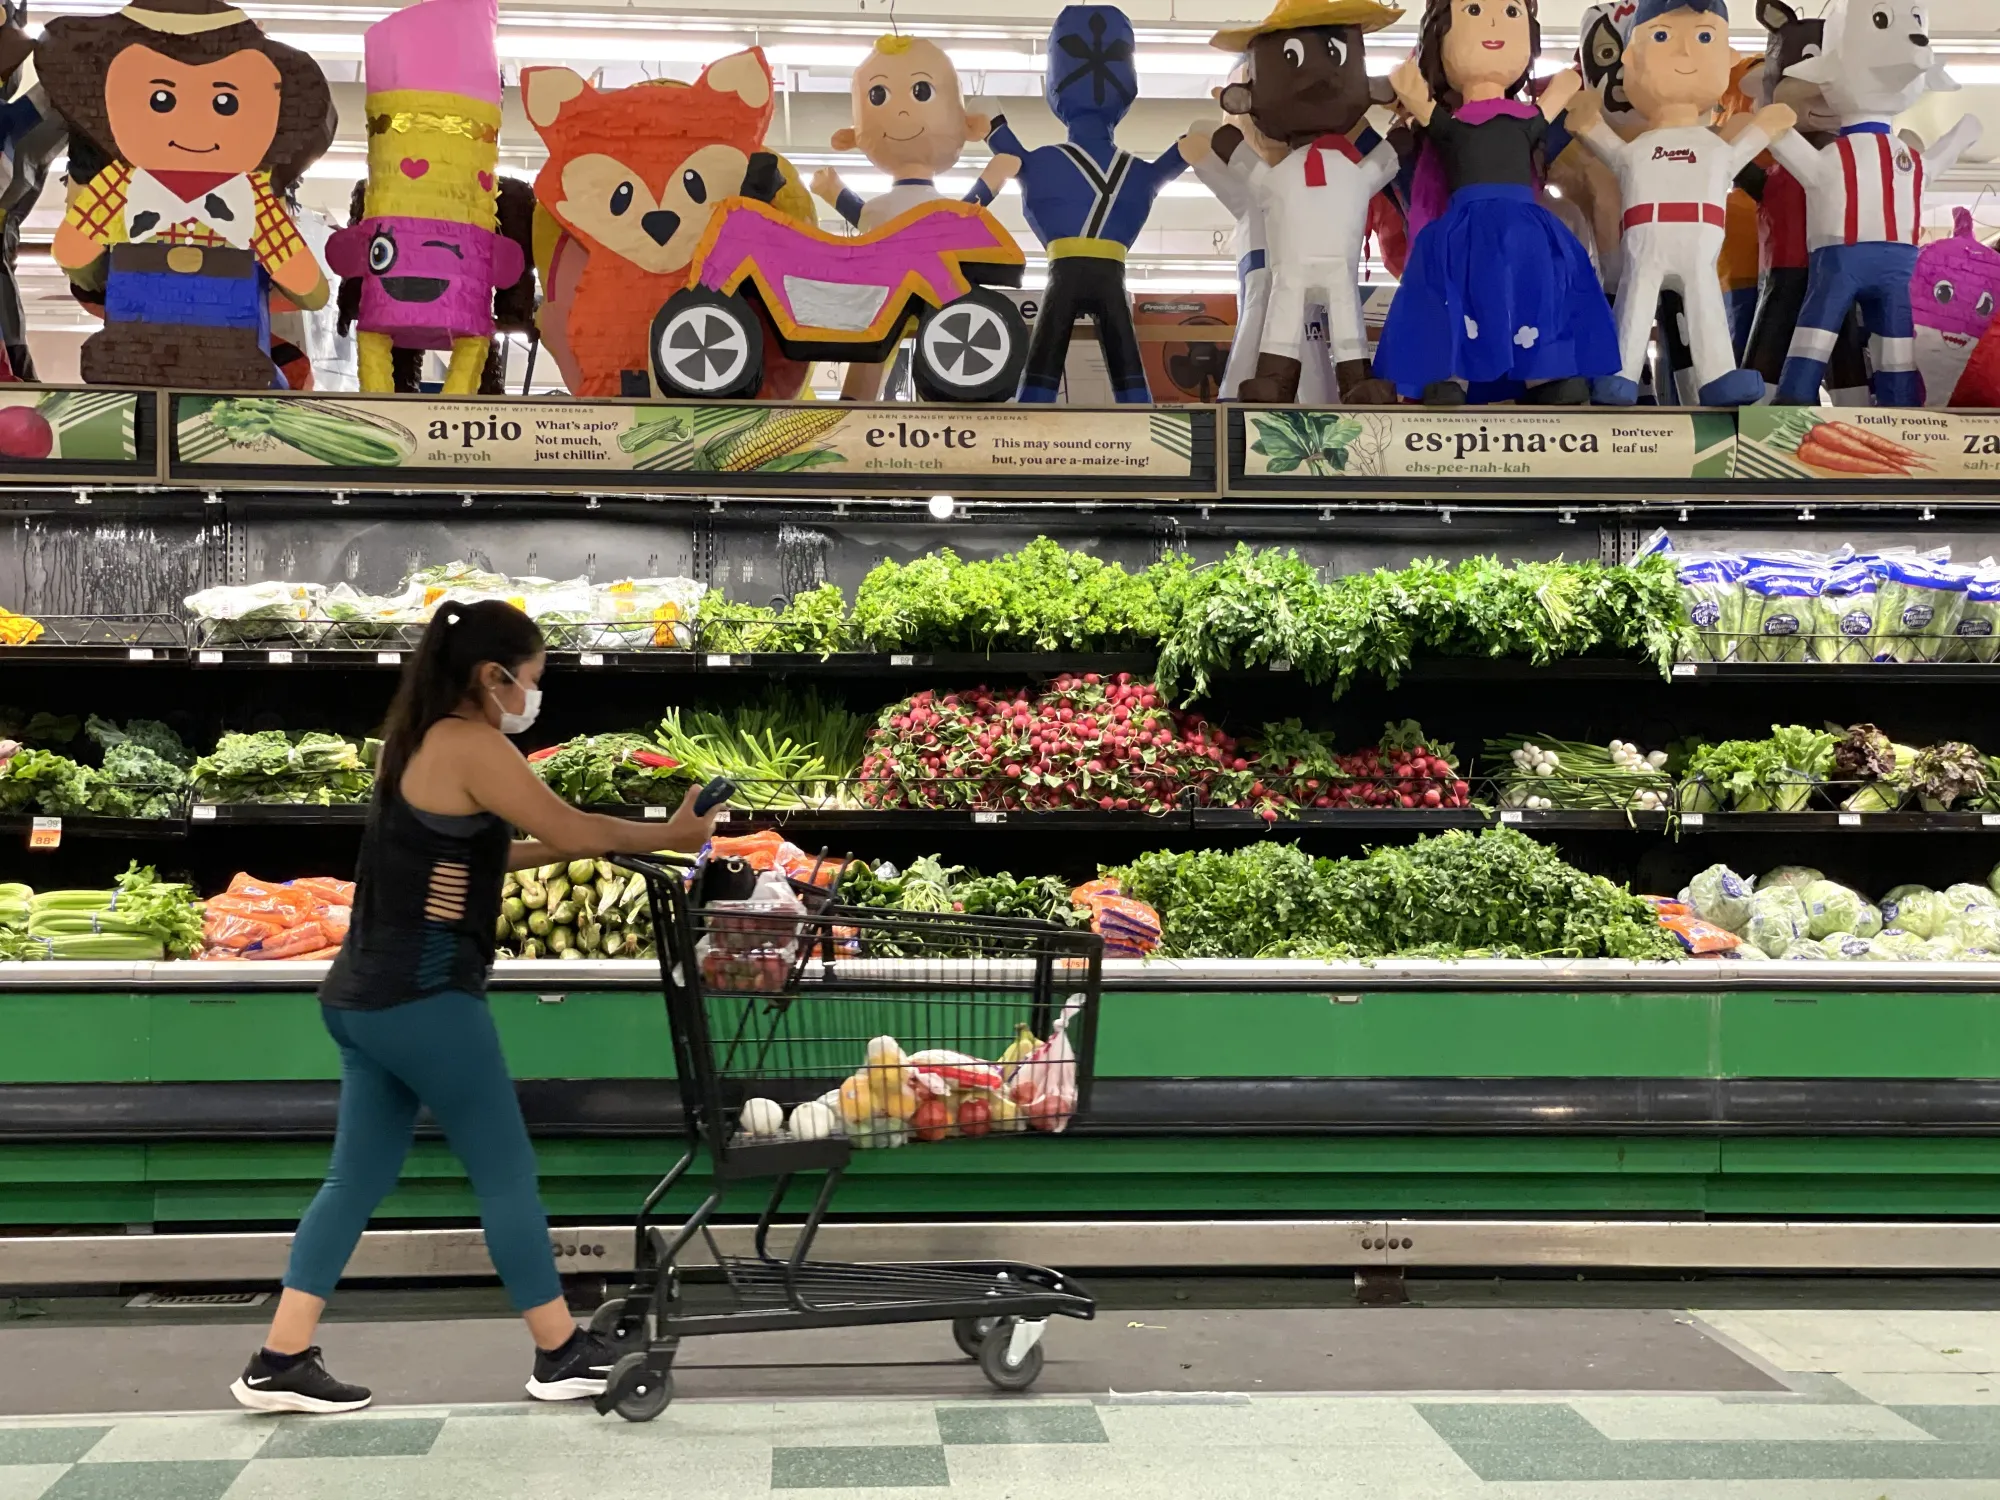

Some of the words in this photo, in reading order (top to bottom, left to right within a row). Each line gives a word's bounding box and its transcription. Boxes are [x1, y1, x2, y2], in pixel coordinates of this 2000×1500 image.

[535, 420, 580, 431] What's
[583, 421, 619, 433] apio?
[1855, 414, 1898, 427] Totally
[1901, 417, 1949, 428] rooting
[534, 435, 558, 445] Not
[561, 435, 602, 447] much,
[1901, 431, 1922, 441] for
[1923, 432, 1950, 443] you.
[992, 438, 1021, 449] This
[1023, 440, 1050, 451] may
[1052, 438, 1092, 450] sound
[1095, 440, 1132, 452] corny
[1611, 443, 1637, 453] leaf
[1639, 443, 1658, 453] us!
[428, 449, 491, 464] ah-pyoh
[534, 450, 560, 462] just
[992, 454, 1017, 466] but,
[1019, 457, 1043, 467] you
[1045, 457, 1067, 466] are
[1069, 456, 1149, 468] a-maize-ing!
[865, 458, 943, 470] eh-loh-teh
[1405, 461, 1531, 476] ehs-pee-nah-kah
